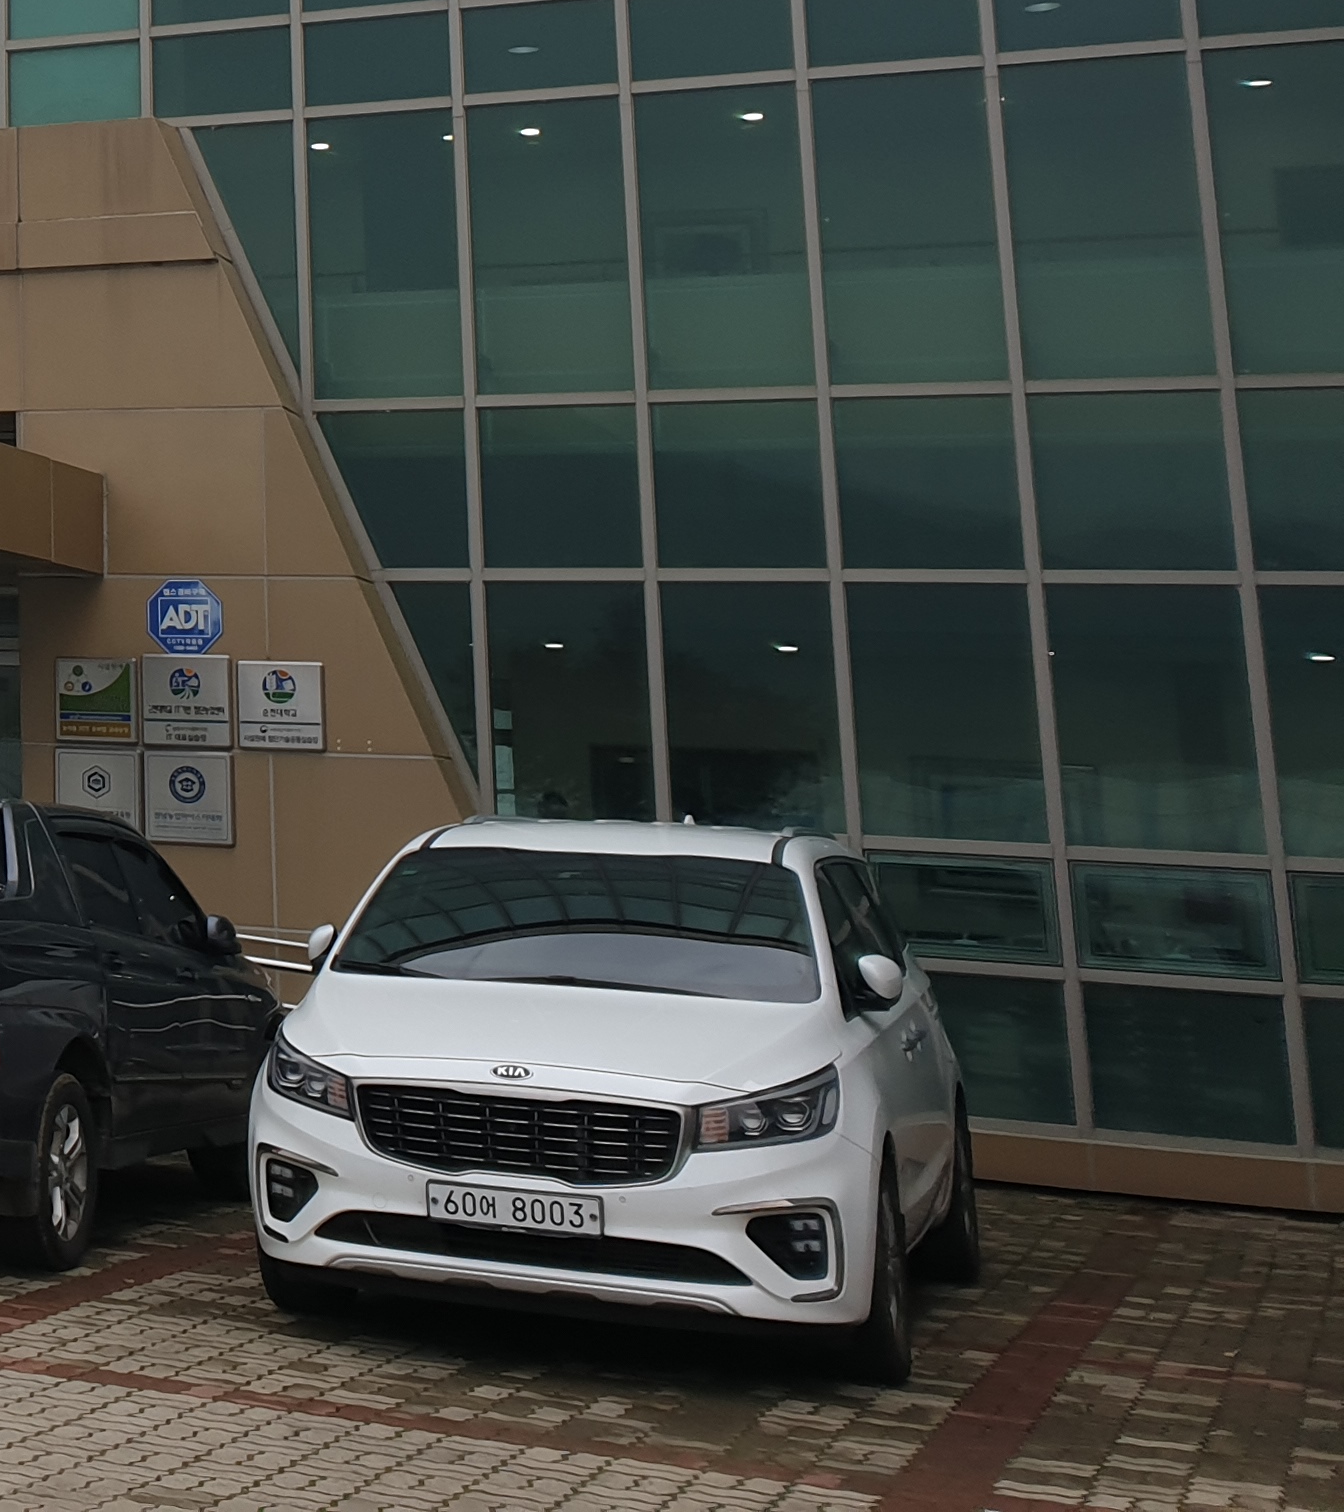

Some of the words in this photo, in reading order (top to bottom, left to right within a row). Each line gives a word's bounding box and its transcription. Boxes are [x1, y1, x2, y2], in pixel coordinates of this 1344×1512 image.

[160, 604, 211, 630] ADT
[496, 1066, 526, 1077] KIA
[443, 1190, 497, 1219] 60어
[511, 1196, 585, 1229] 8003
